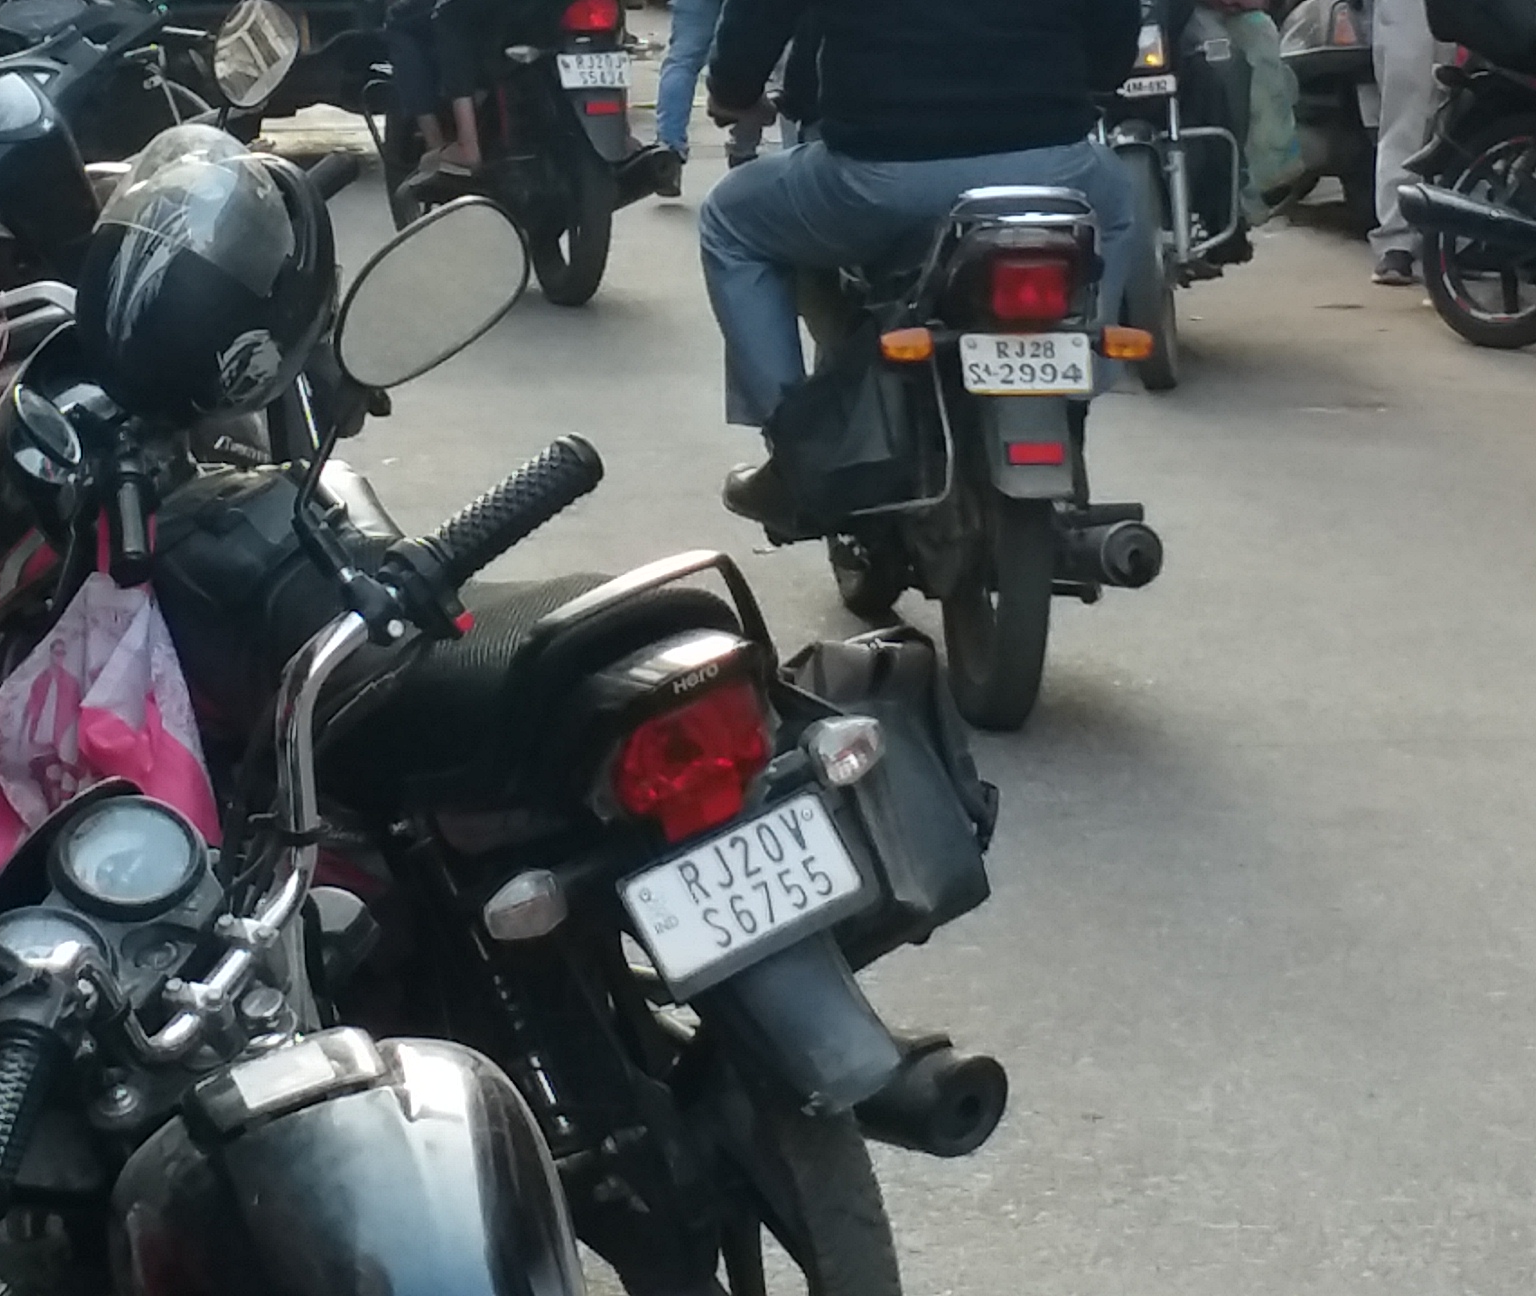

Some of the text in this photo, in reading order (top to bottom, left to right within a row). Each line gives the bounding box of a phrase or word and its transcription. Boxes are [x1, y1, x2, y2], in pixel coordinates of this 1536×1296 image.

[995, 340, 1056, 359] RJ28
[677, 808, 807, 905] RJ20V
[703, 855, 833, 949] S6755
